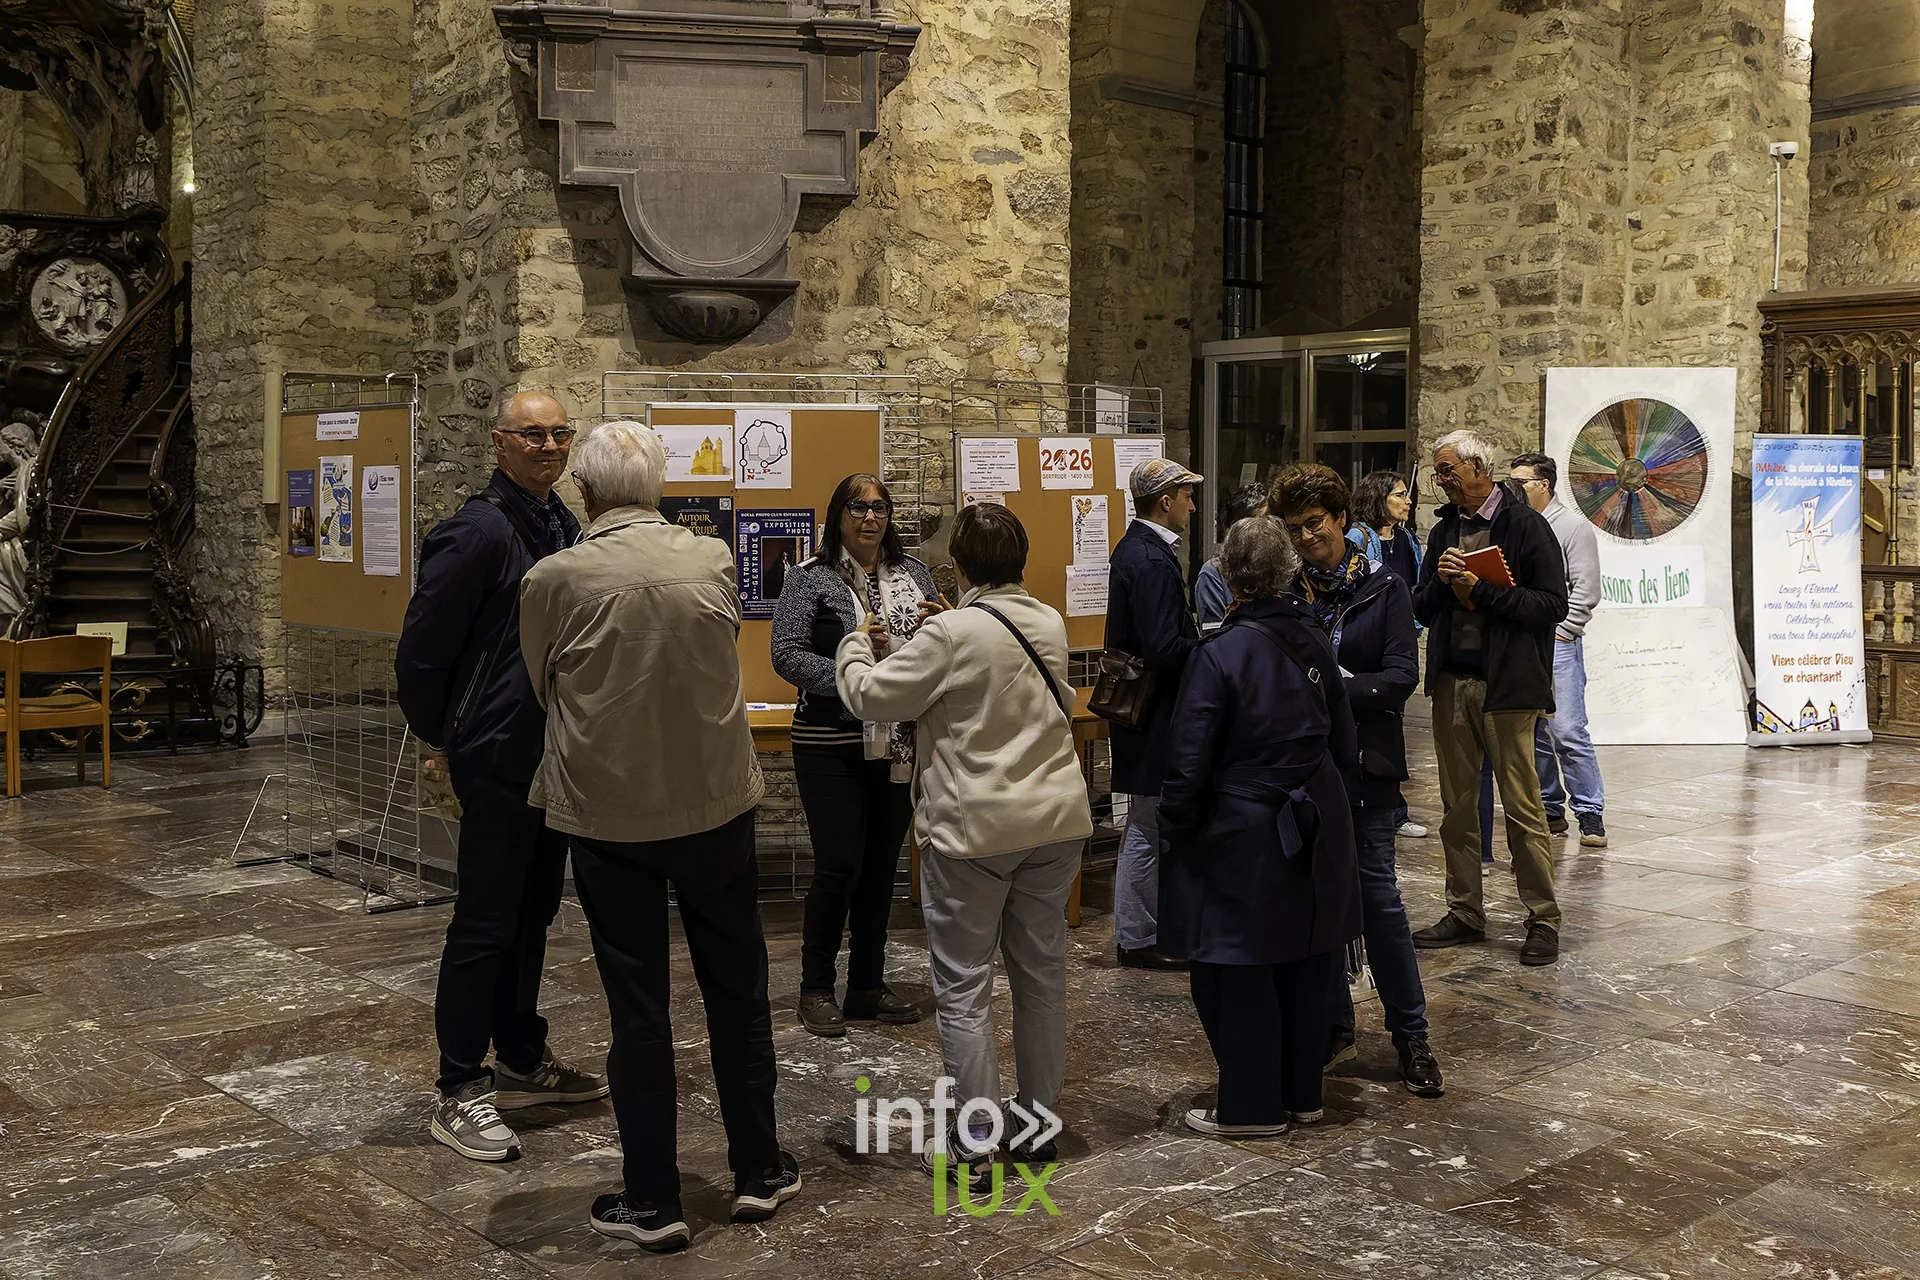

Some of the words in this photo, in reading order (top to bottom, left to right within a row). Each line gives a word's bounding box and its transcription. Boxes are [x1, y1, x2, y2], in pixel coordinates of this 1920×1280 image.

[1041, 449, 1092, 471] 2026
[1798, 463, 1824, 472] chorale
[1826, 463, 1838, 472] des
[1765, 476, 1774, 486] de
[677, 512, 712, 523] AUTOUR
[686, 525, 719, 536] TRUDE
[744, 578, 749, 587] LE
[1602, 575, 1633, 604] ssons
[1640, 569, 1658, 604] des
[1664, 565, 1689, 601] liens
[1779, 584, 1802, 597] Louez
[1784, 600, 1807, 609] toutes
[1810, 599, 1821, 608] les
[1807, 630, 1818, 639] les
[1772, 654, 1794, 666] Viens
[1798, 654, 1832, 665] célébrer
[1835, 653, 1854, 665] Dieu
[1783, 674, 1793, 683] en
[1796, 670, 1842, 682] chantant!
